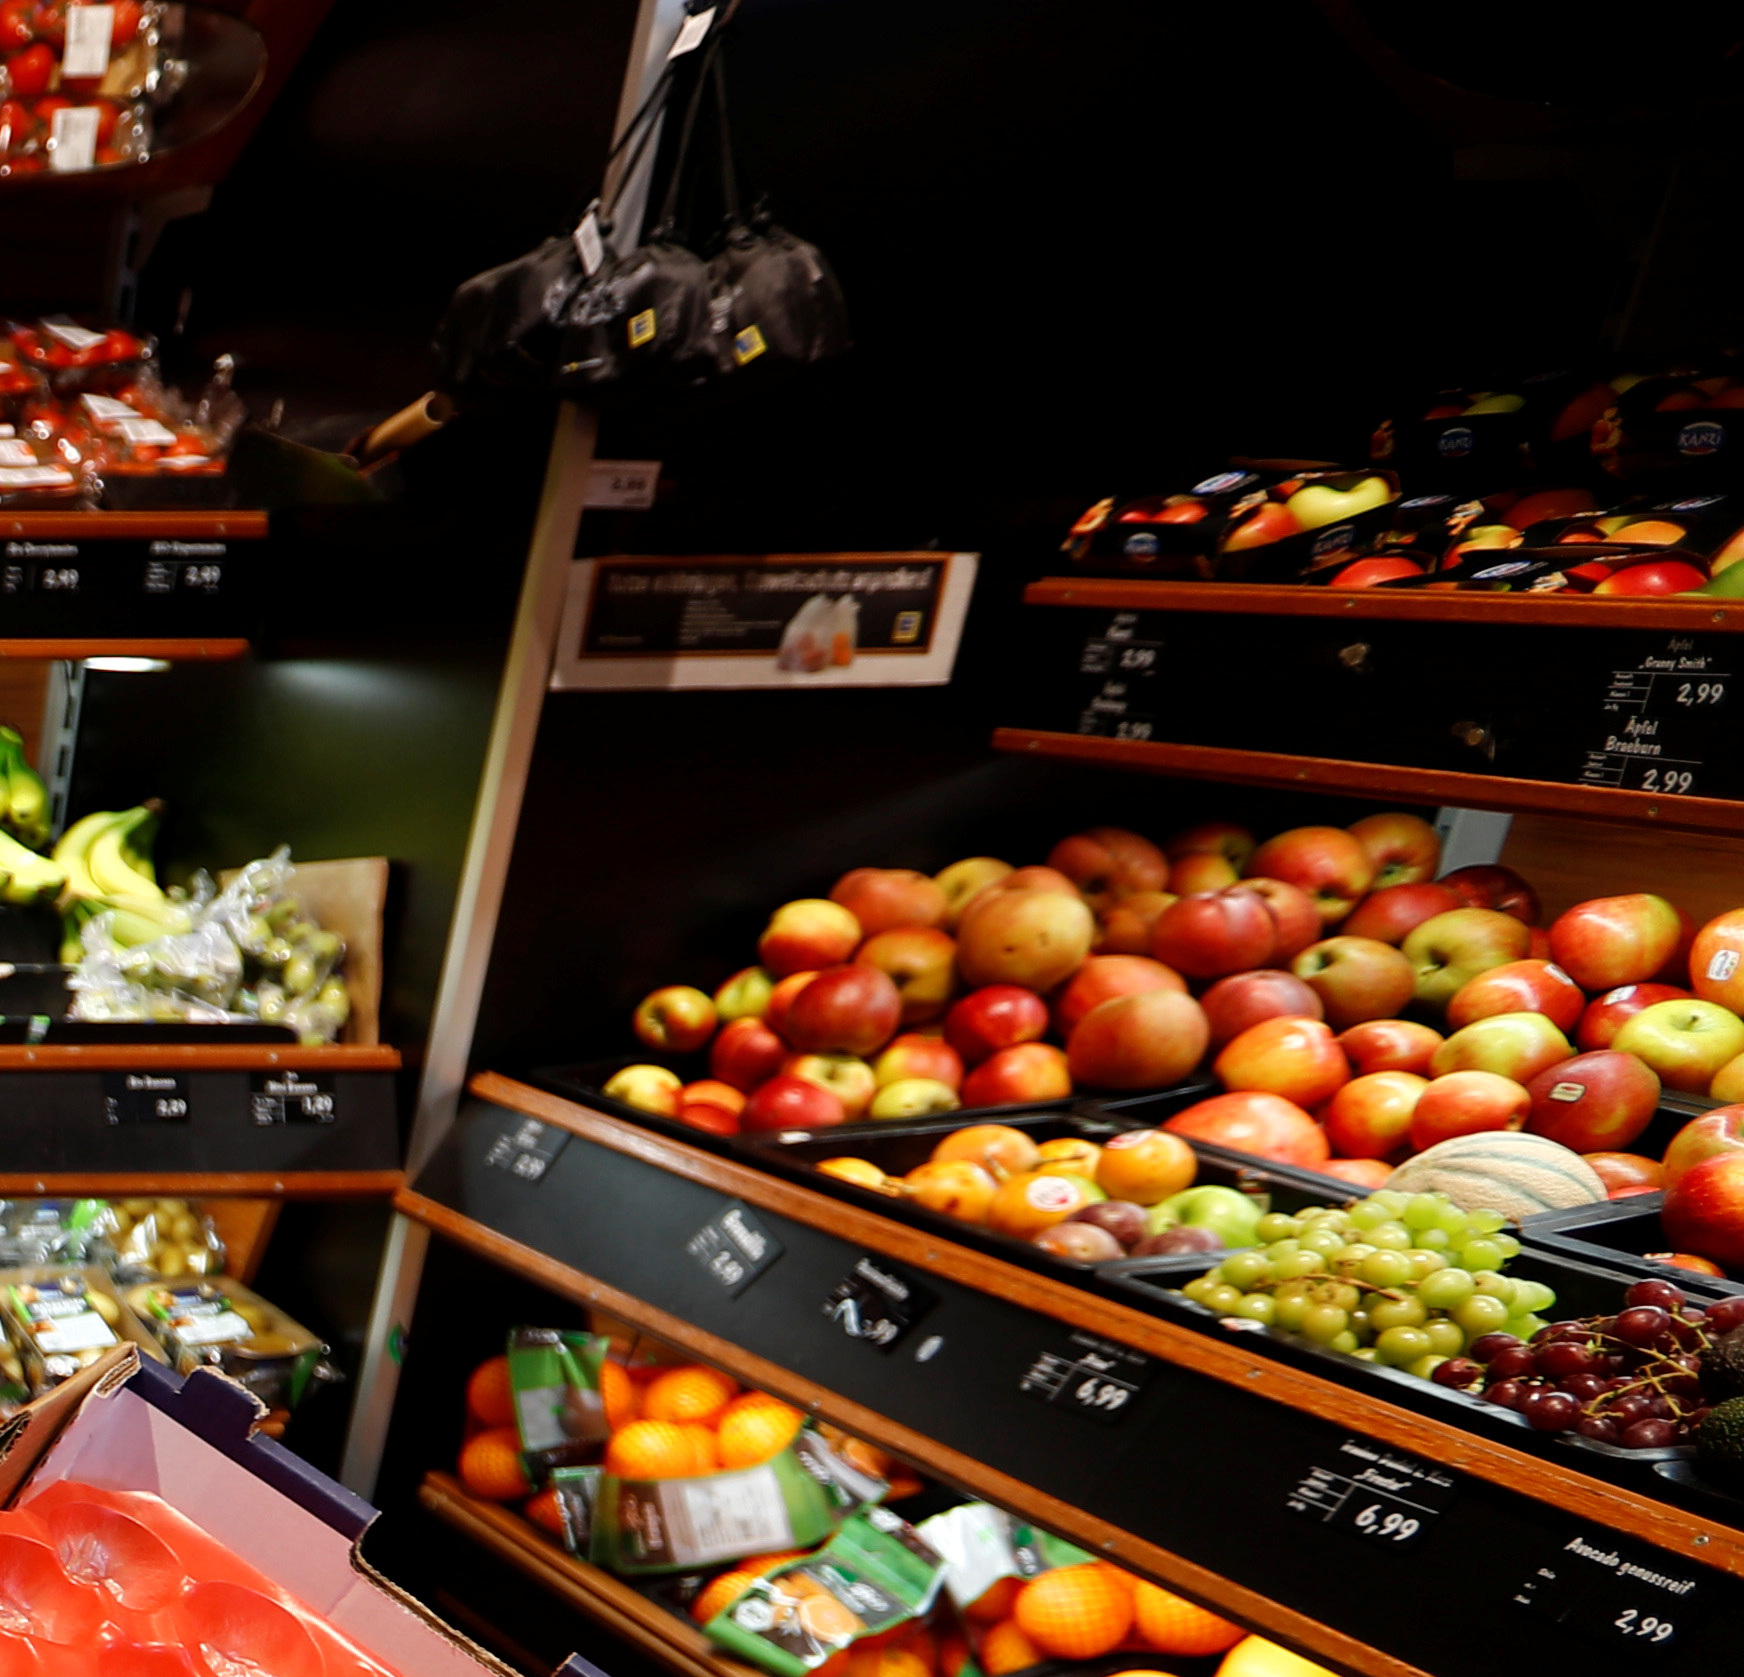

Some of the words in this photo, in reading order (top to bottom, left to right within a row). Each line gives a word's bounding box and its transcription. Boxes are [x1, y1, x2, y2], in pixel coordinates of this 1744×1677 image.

[1677, 433, 1721, 447] KANZI
[1675, 682, 1725, 706] 2,99
[1624, 714, 1658, 737] Äpfel
[1606, 735, 1661, 756] Braeburn
[1641, 767, 1694, 795] 2,99
[1075, 1378, 1129, 1410] 6,99
[1354, 1503, 1420, 1542] 6,99
[1564, 1536, 1619, 1572] Avocado
[1618, 1558, 1696, 1600] genussreif
[1612, 1608, 1674, 1645] 2,99
